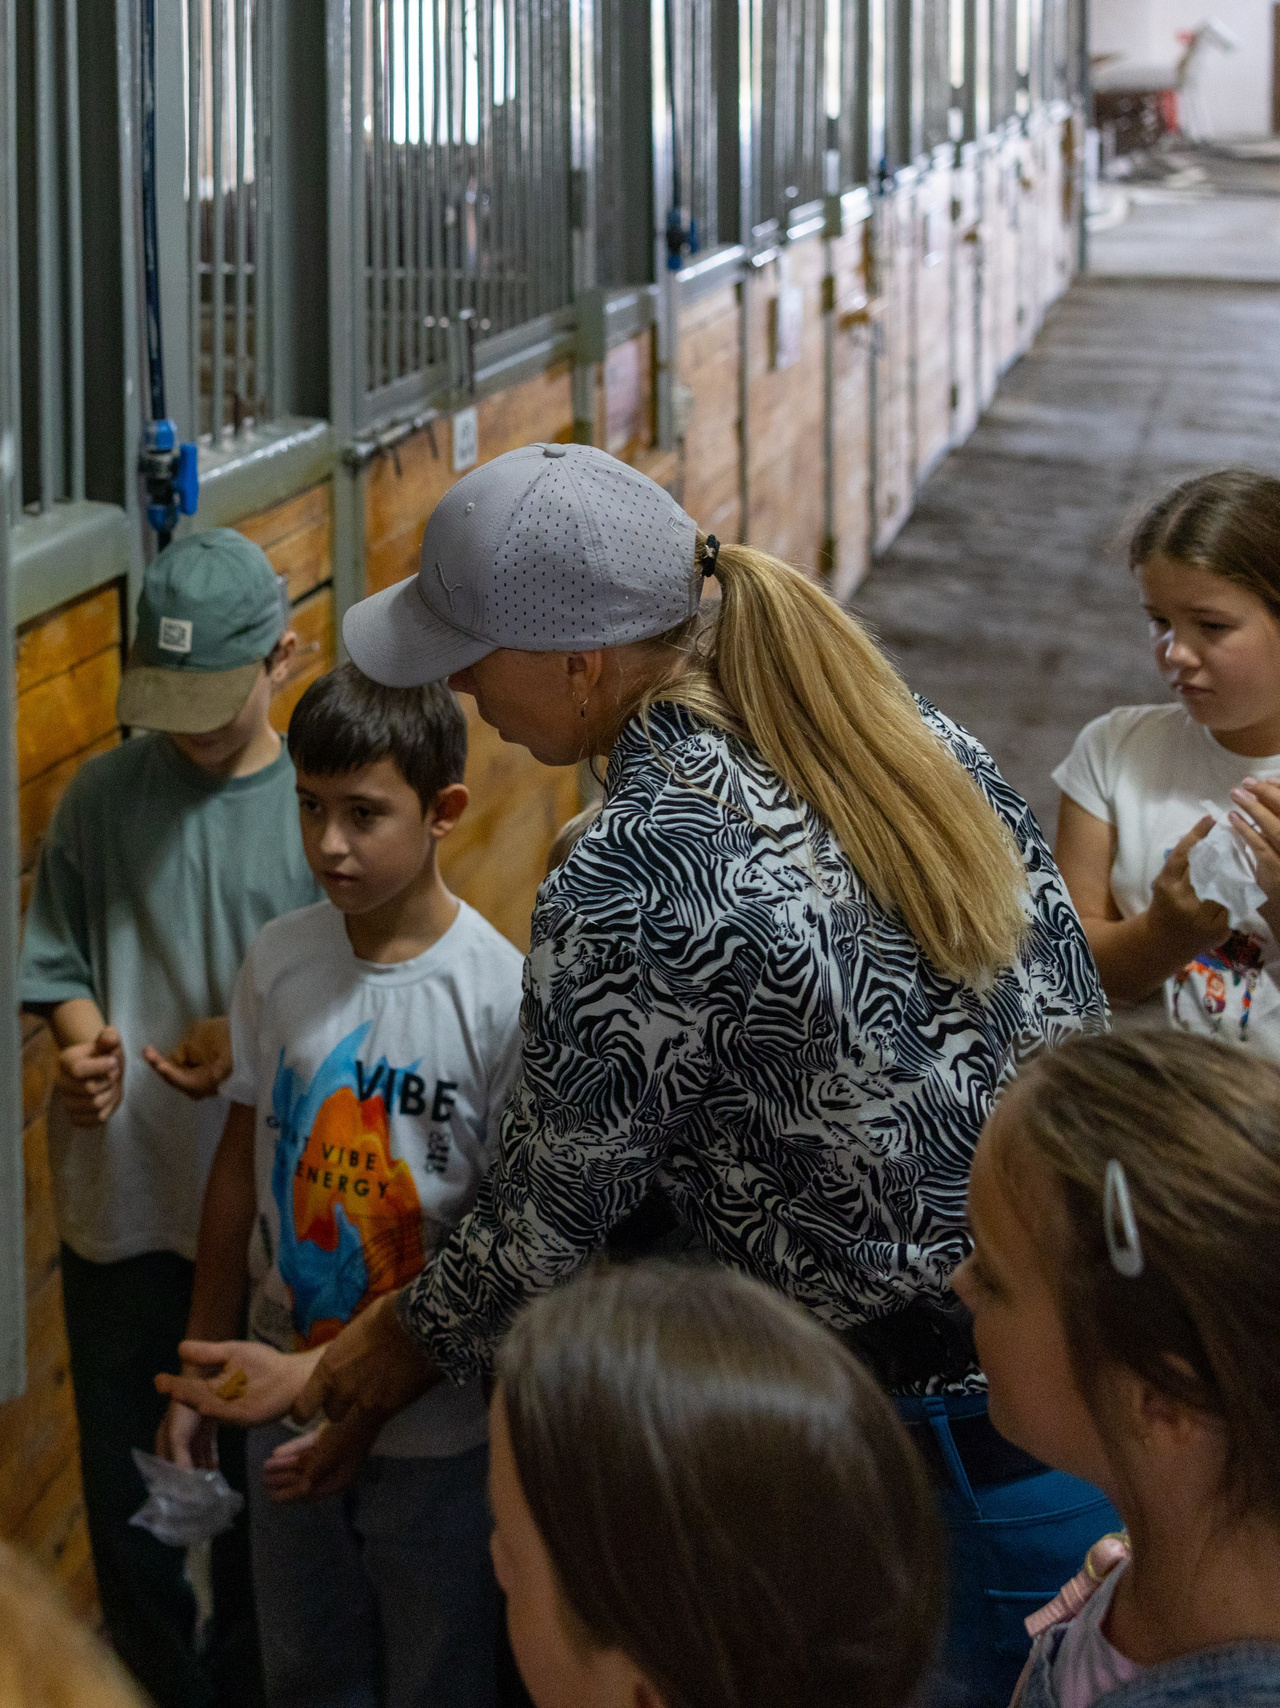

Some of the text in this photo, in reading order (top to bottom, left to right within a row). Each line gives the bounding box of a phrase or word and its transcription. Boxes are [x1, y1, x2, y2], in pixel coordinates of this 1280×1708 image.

[355, 1060, 458, 1122] VIBE
[321, 1142, 376, 1171] VIBE
[296, 1160, 390, 1199] ENERGY
